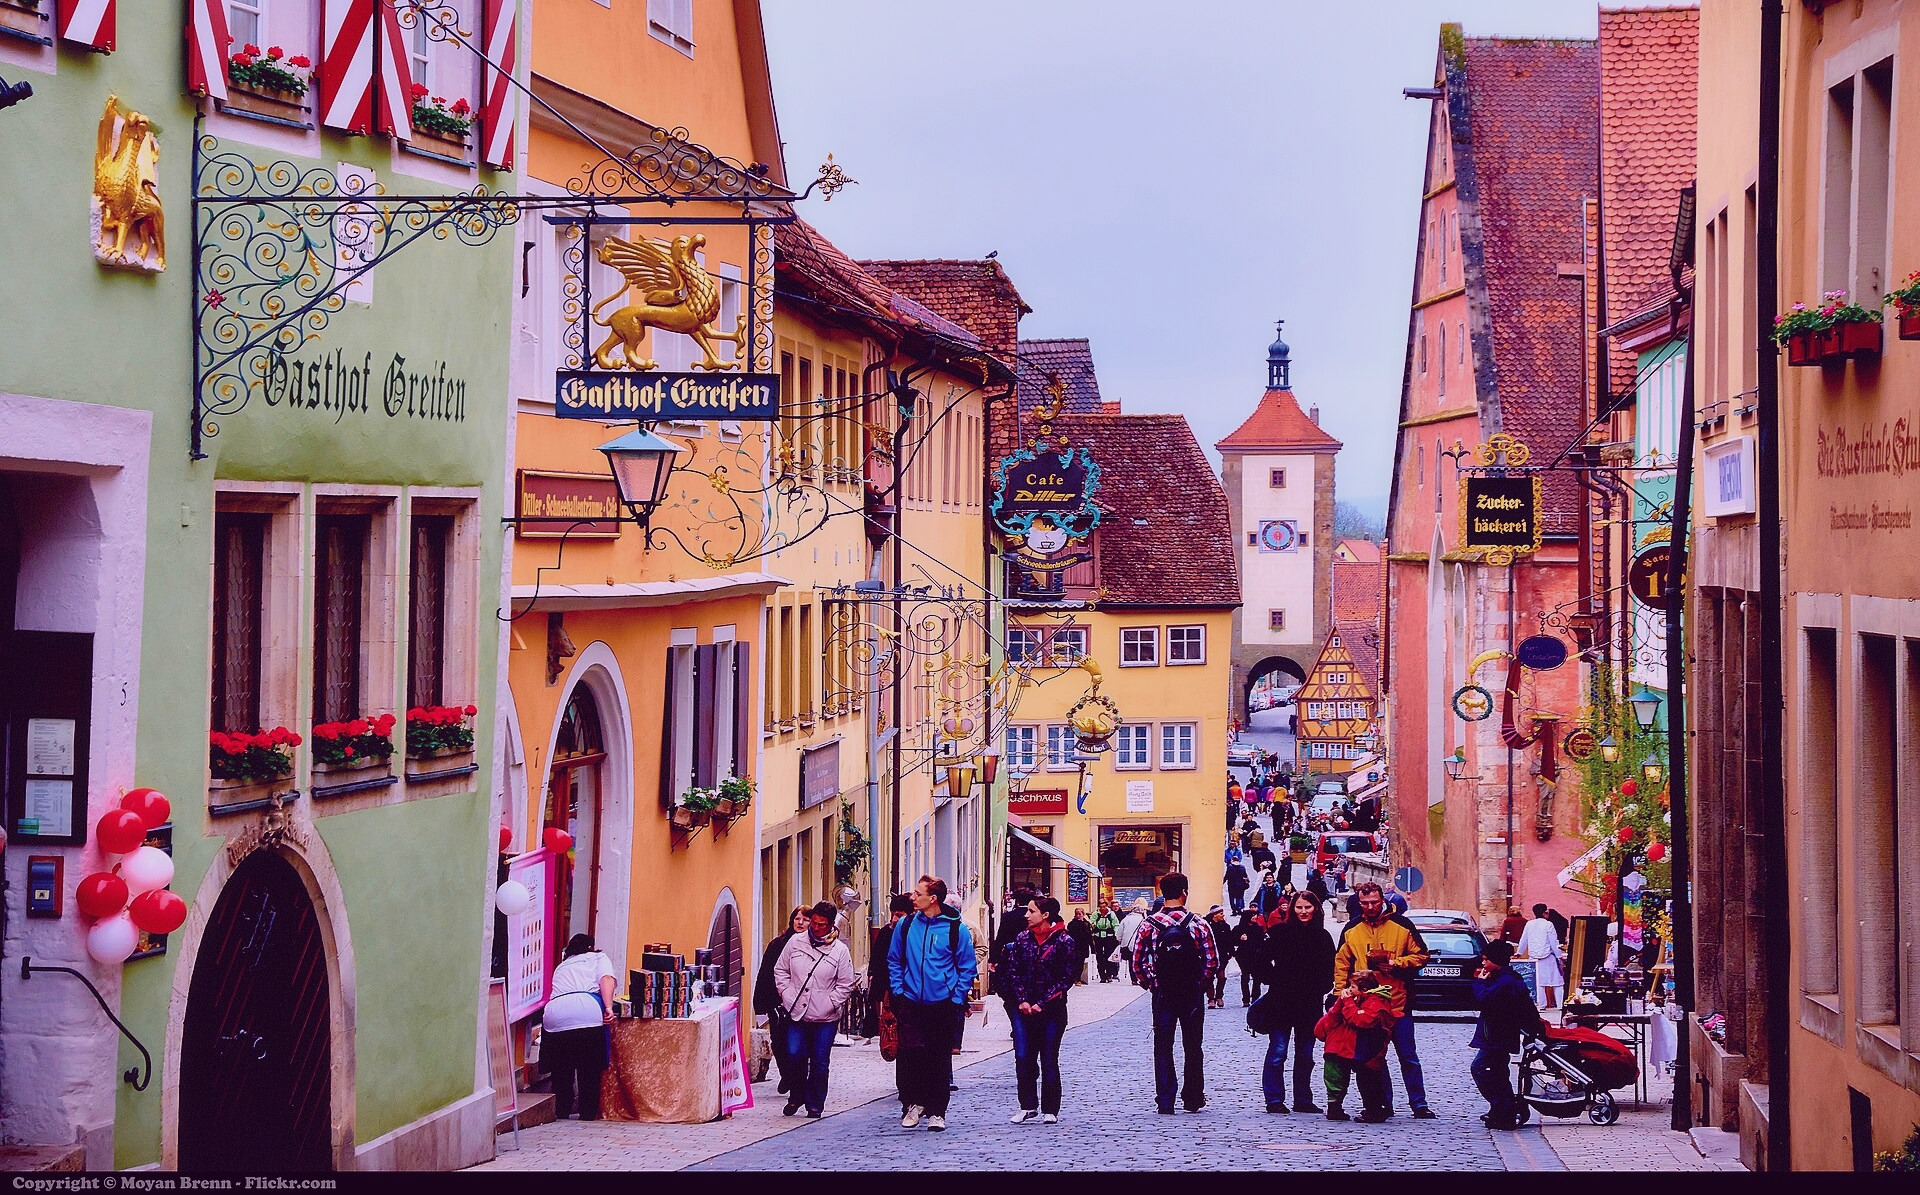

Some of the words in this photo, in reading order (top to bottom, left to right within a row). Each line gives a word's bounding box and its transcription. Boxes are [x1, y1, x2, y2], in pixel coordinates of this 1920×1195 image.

[263, 338, 371, 425] Gasthof
[383, 351, 466, 423] Greifen
[561, 376, 669, 413] Gasthof
[670, 376, 770, 413] Greifen
[1817, 424, 1834, 479] Die
[1892, 410, 1920, 479] Stu
[1026, 473, 1064, 485] Cafe
[523, 492, 542, 516] Diller
[1014, 490, 1076, 501] Diller
[1475, 494, 1525, 511] Zucker-
[1473, 517, 1527, 534] bäckerei
